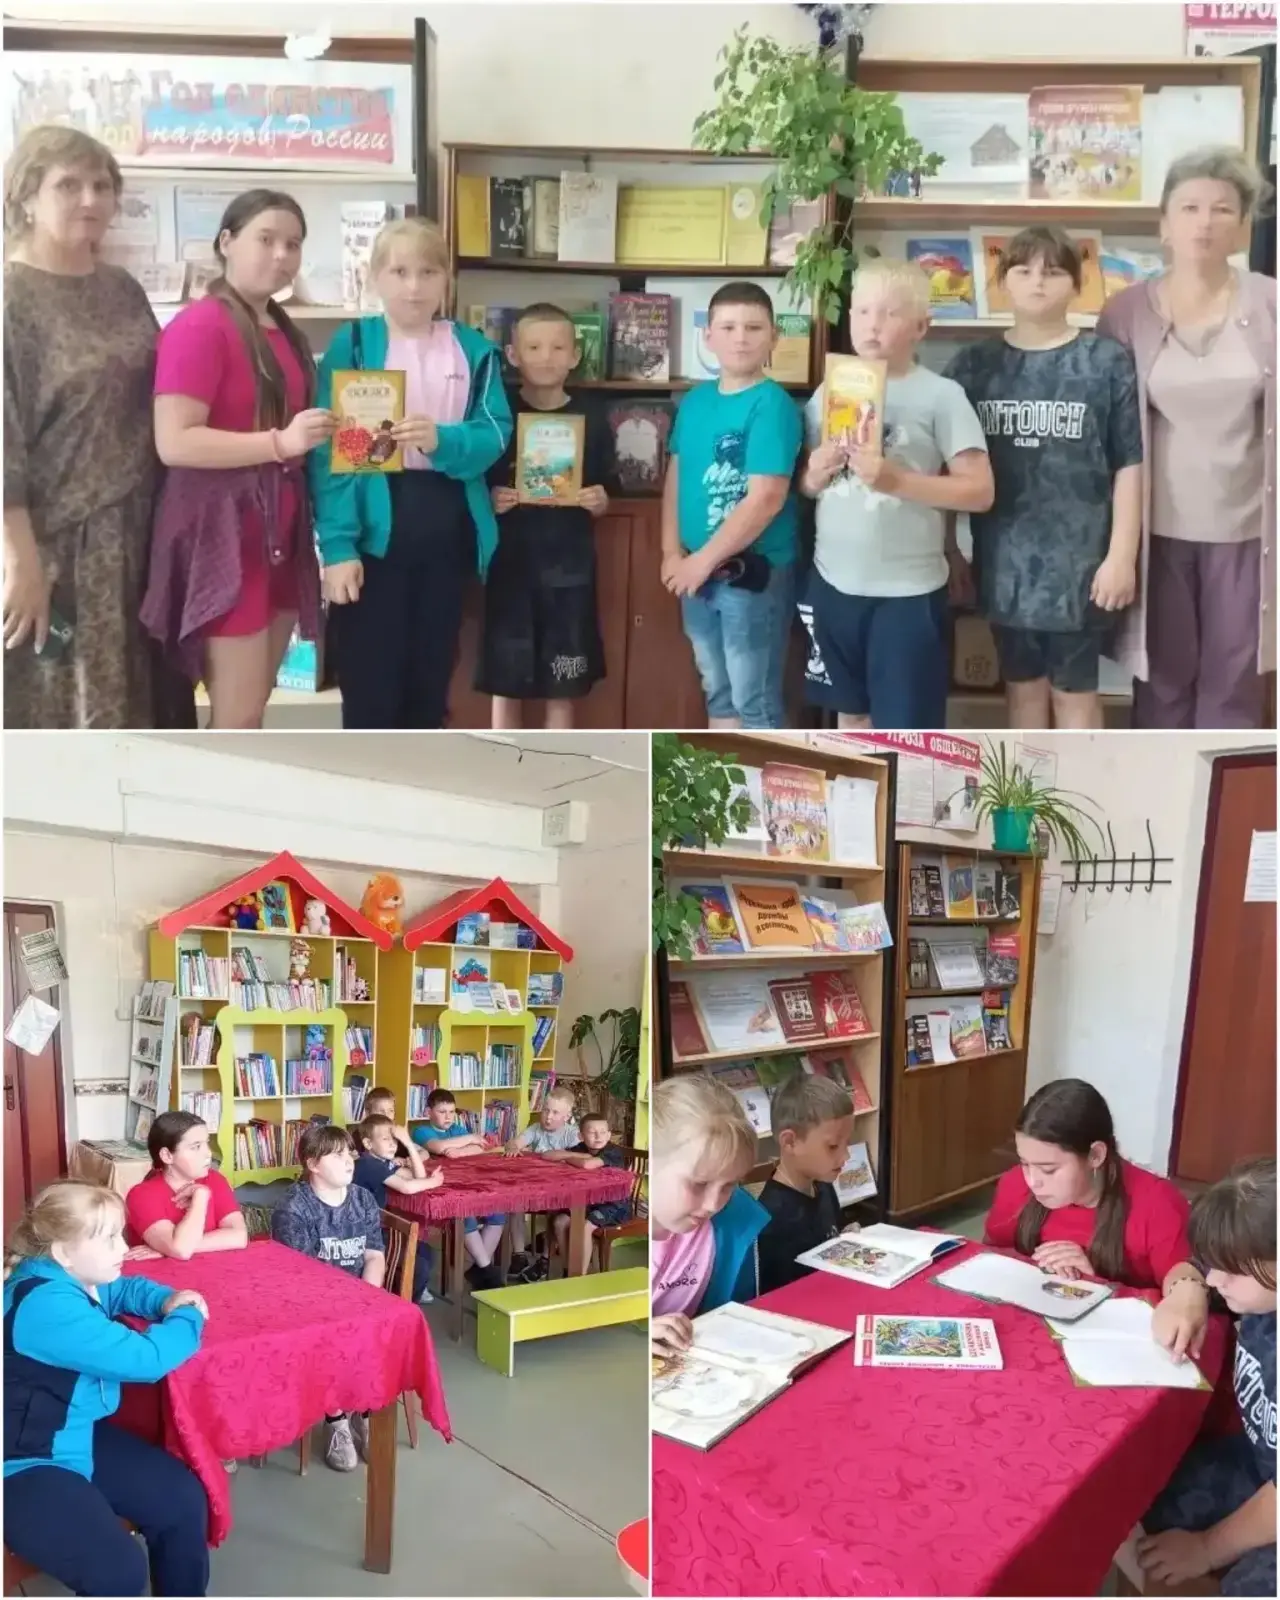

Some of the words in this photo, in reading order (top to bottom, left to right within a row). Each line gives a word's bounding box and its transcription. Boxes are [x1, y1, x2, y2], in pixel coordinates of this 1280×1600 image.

[1209, 4, 1277, 19] ТЕРРО
[151, 114, 273, 153] народов
[284, 113, 389, 151] России
[1014, 437, 1039, 447] CLUB
[304, 1076, 316, 1085] 6+
